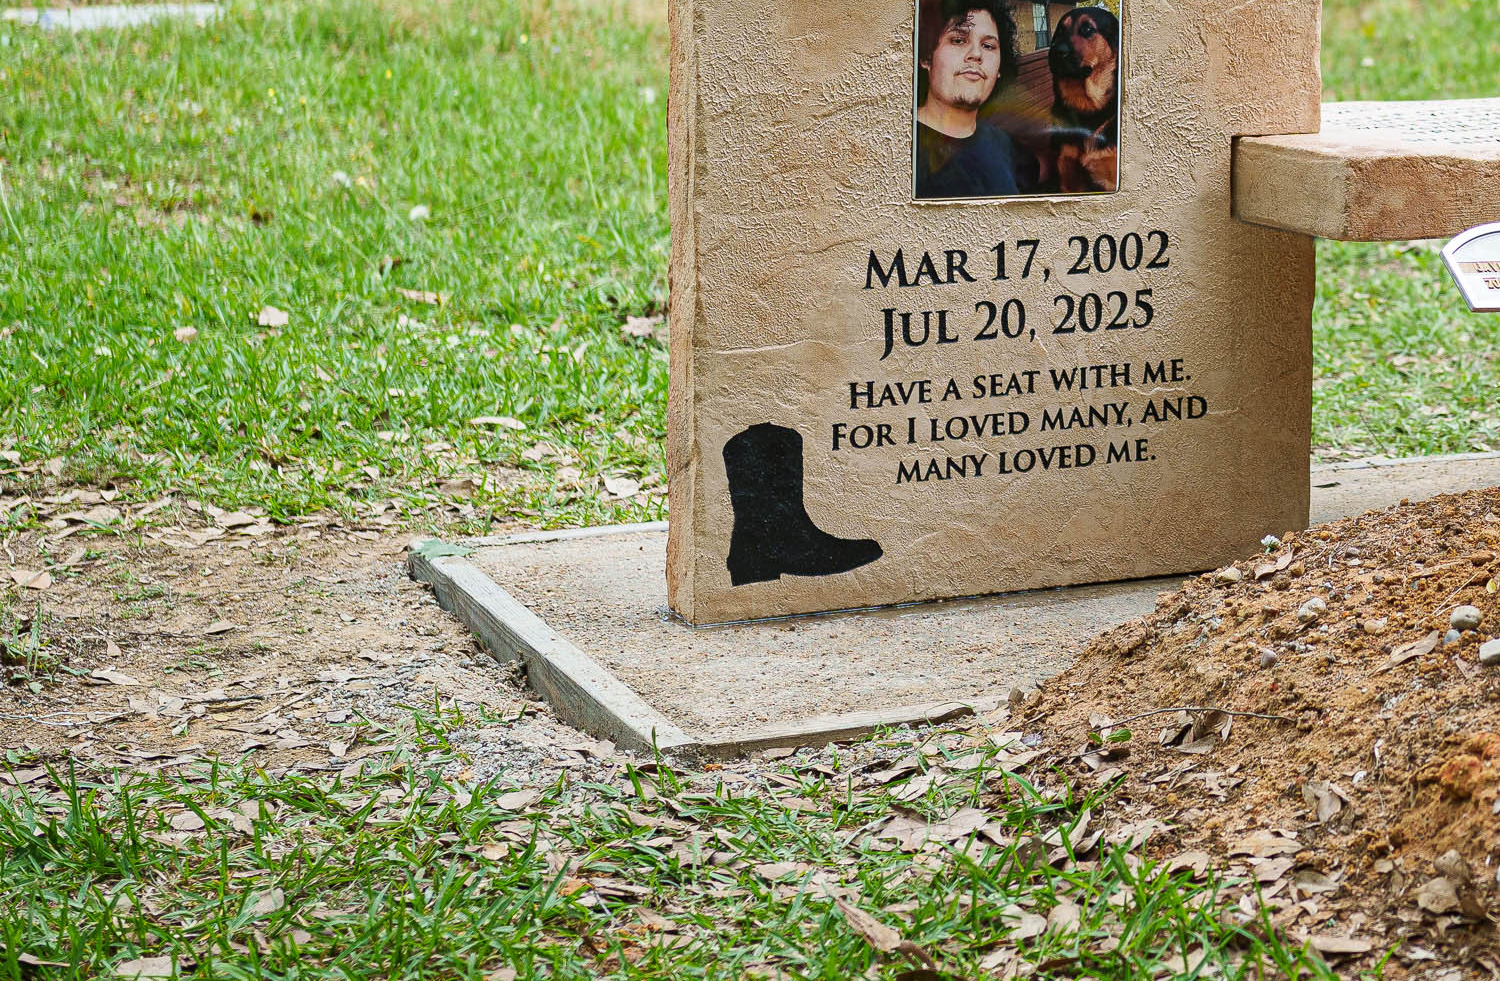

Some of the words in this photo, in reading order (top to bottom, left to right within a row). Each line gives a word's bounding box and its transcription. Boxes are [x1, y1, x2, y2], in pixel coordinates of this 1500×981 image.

[863, 248, 977, 290] MAR
[990, 239, 1051, 283] 17,
[1066, 230, 1170, 276] 2002
[880, 308, 959, 361] JUL
[973, 298, 1036, 343] 20,
[1053, 288, 1154, 336] 2025
[848, 380, 931, 410] HAVE
[941, 378, 963, 402] A
[972, 370, 1041, 398] SEAT
[1048, 363, 1133, 392] WITH
[1142, 359, 1192, 387] ME.
[831, 423, 897, 452] FOR
[907, 417, 917, 445] I
[930, 411, 1030, 443] LOVED
[1040, 402, 1133, 432] MANY,
[1140, 395, 1208, 424] AND
[896, 454, 988, 485] MANY
[998, 444, 1097, 475] LOVED
[1106, 439, 1157, 465] ME.
